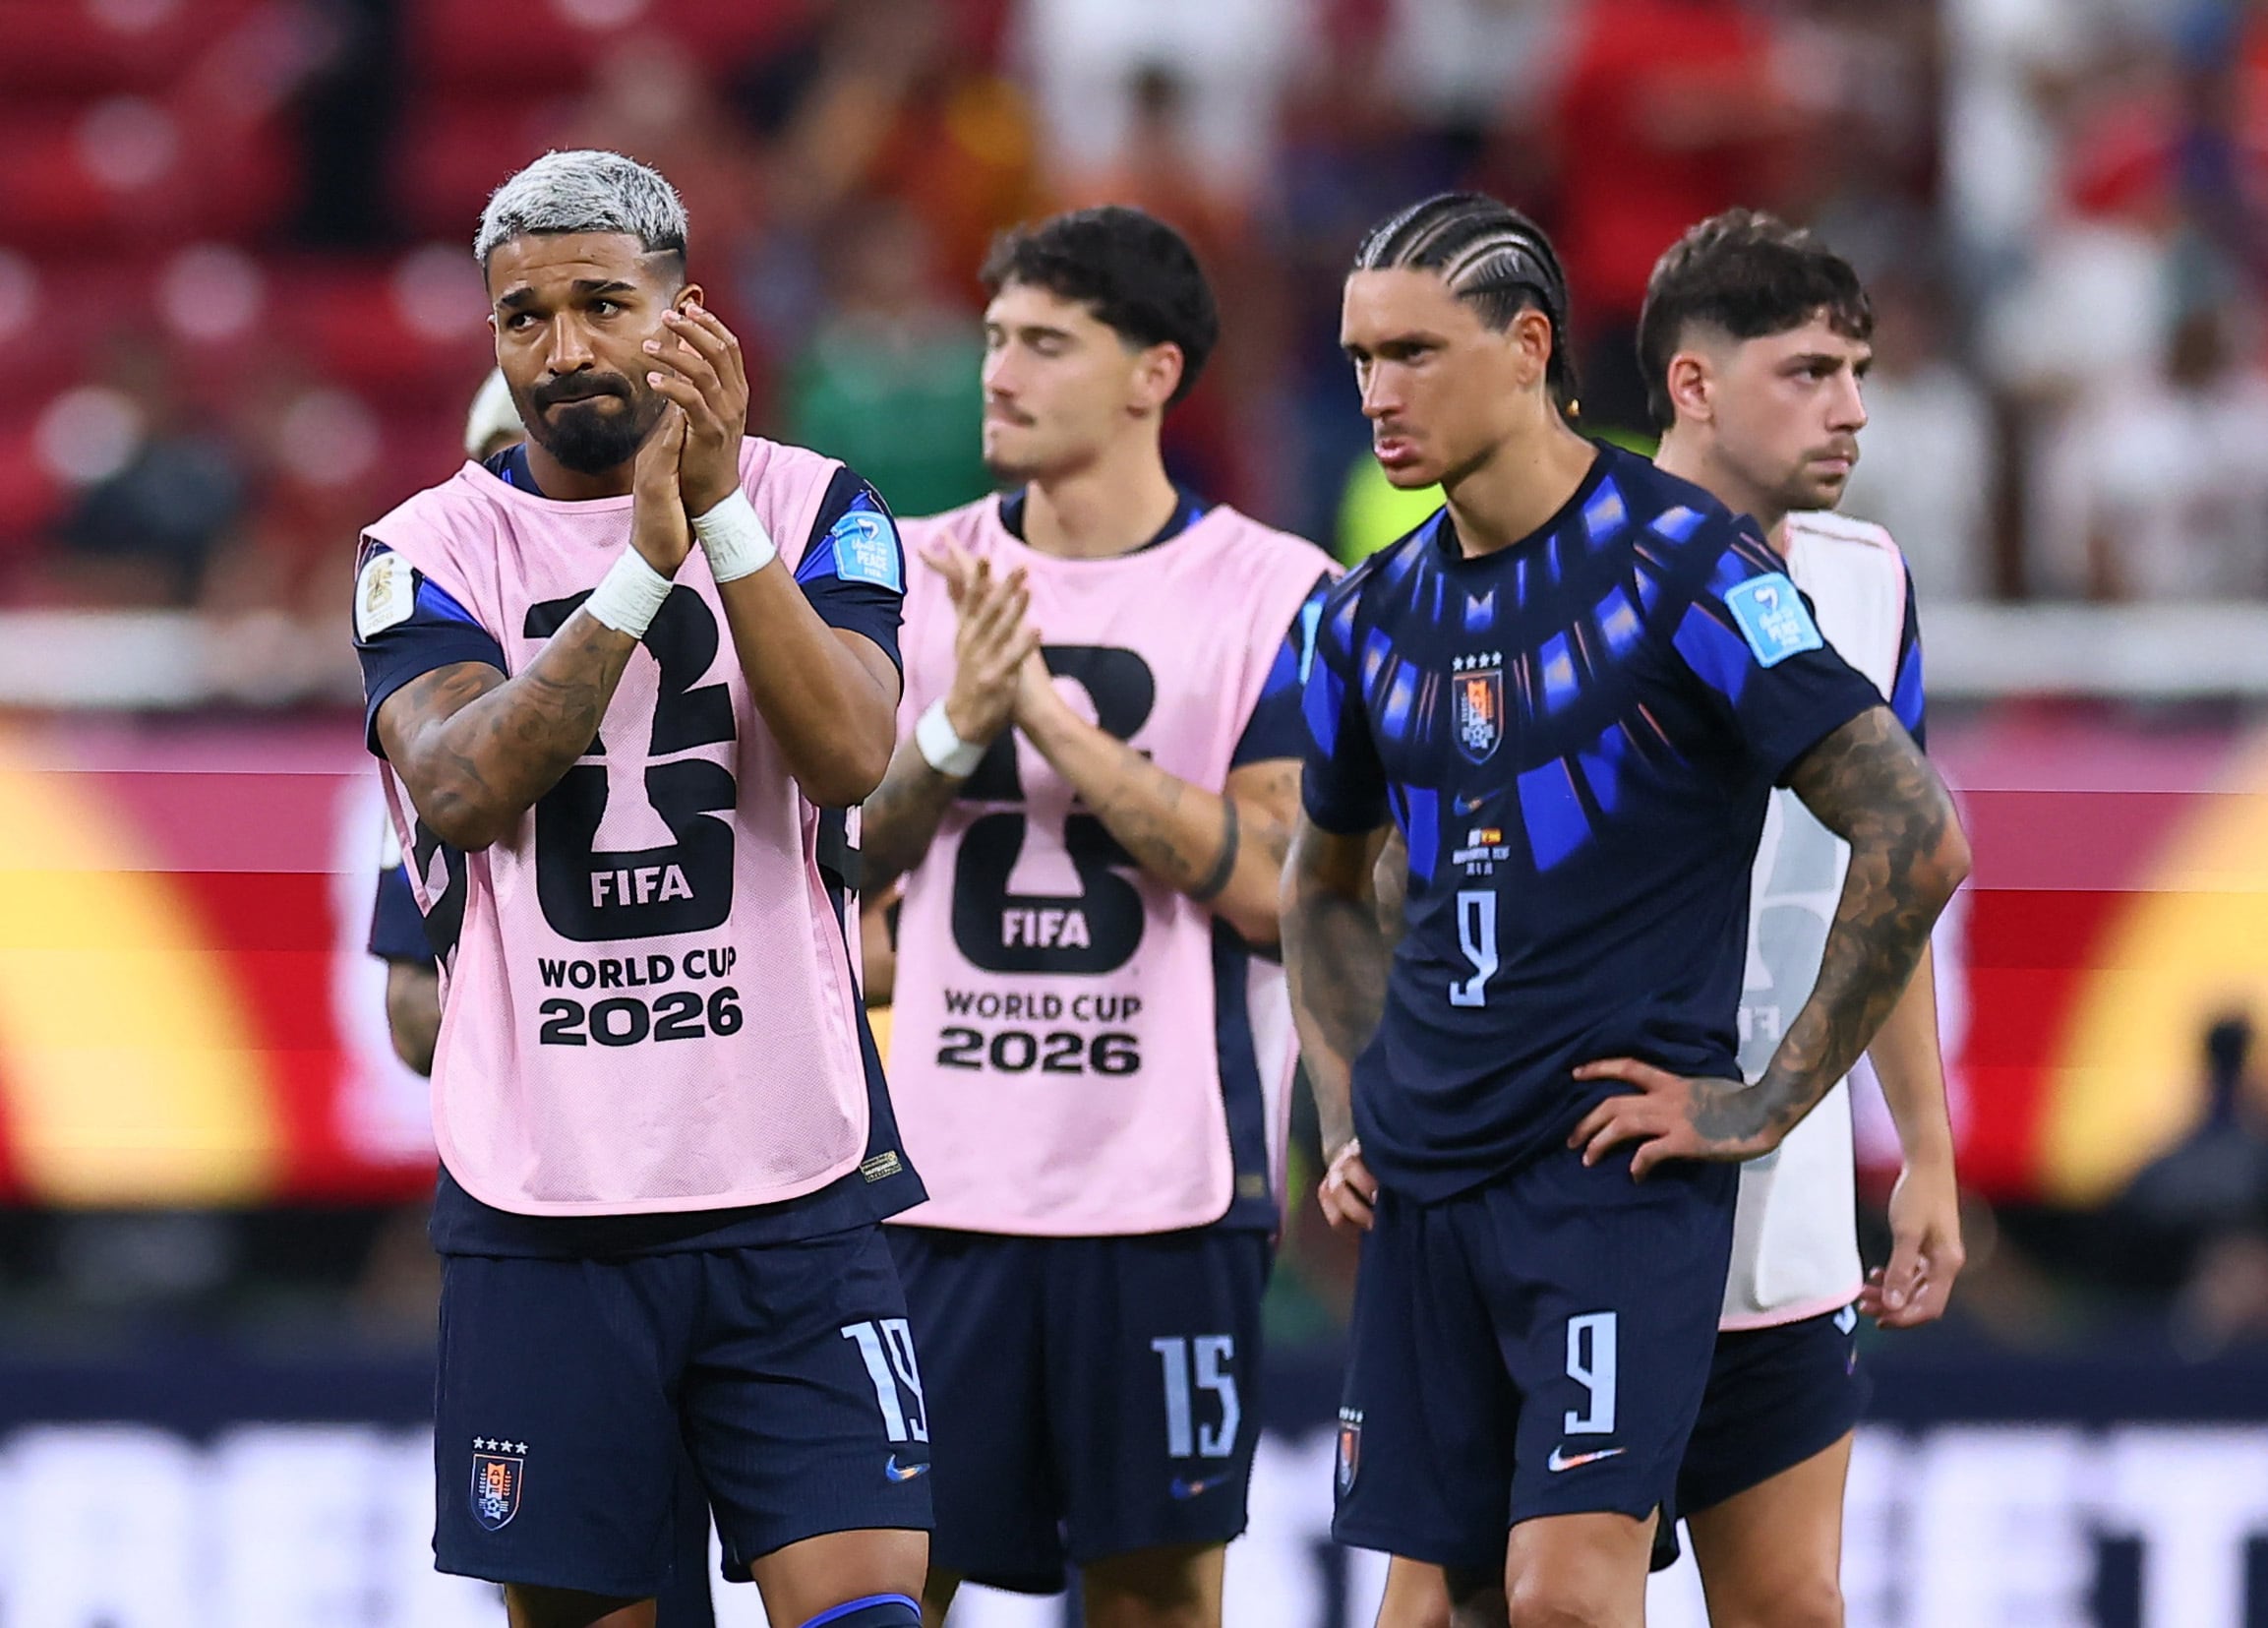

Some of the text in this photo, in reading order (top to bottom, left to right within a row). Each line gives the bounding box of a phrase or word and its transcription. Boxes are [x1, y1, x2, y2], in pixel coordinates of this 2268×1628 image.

[590, 864, 694, 908] FIFA
[1001, 908, 1091, 949] FIFA
[1450, 890, 1498, 1007] 9
[537, 945, 737, 990] WORLD CUP
[539, 986, 745, 1048] 2026
[944, 989, 1143, 1023] WORLD CUP
[935, 1026, 1142, 1077] 2026
[841, 1318, 929, 1444] 19
[1152, 1335, 1240, 1458] 15
[1564, 1311, 1617, 1435] 9
